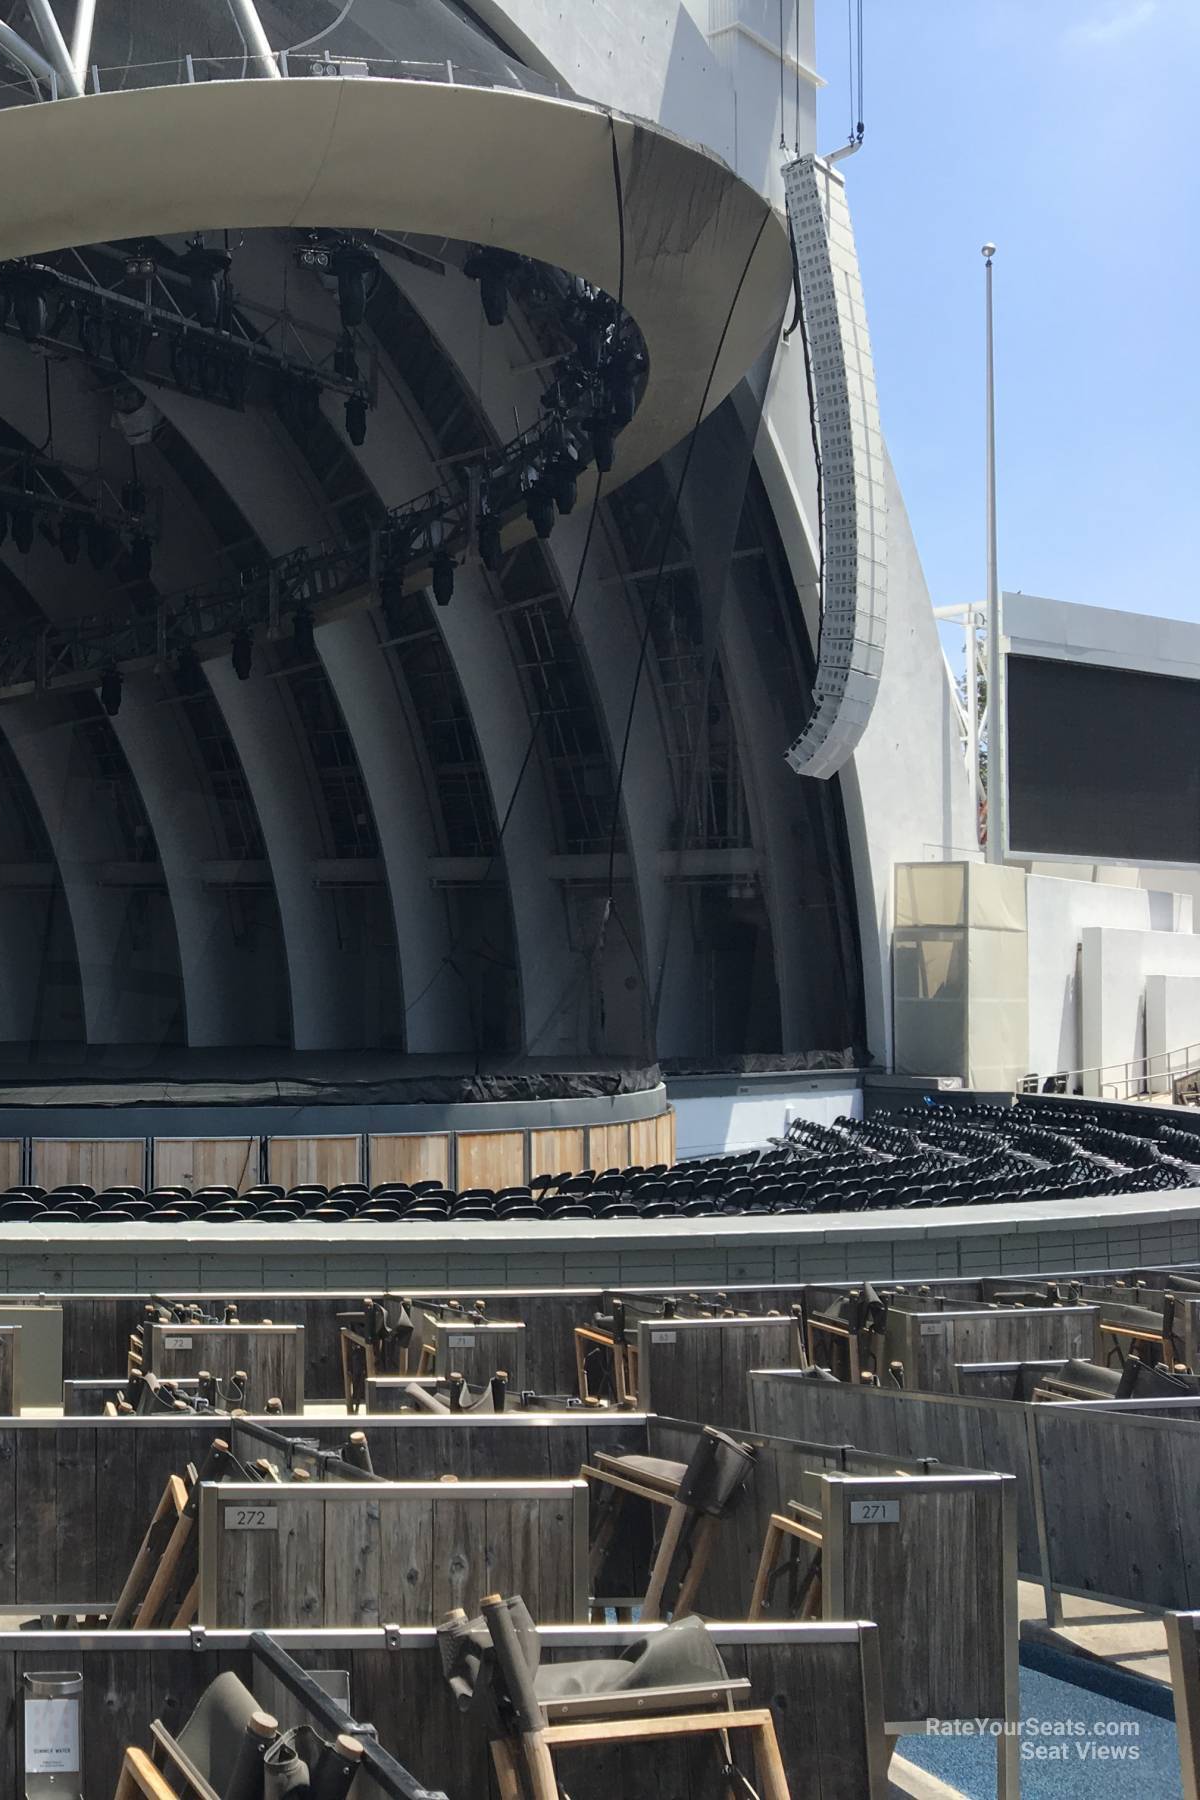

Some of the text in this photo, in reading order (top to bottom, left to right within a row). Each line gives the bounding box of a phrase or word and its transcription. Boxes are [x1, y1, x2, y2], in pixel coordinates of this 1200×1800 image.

[174, 1339, 184, 1348] 72
[237, 1511, 265, 1525] 272
[863, 1505, 886, 1519] 271
